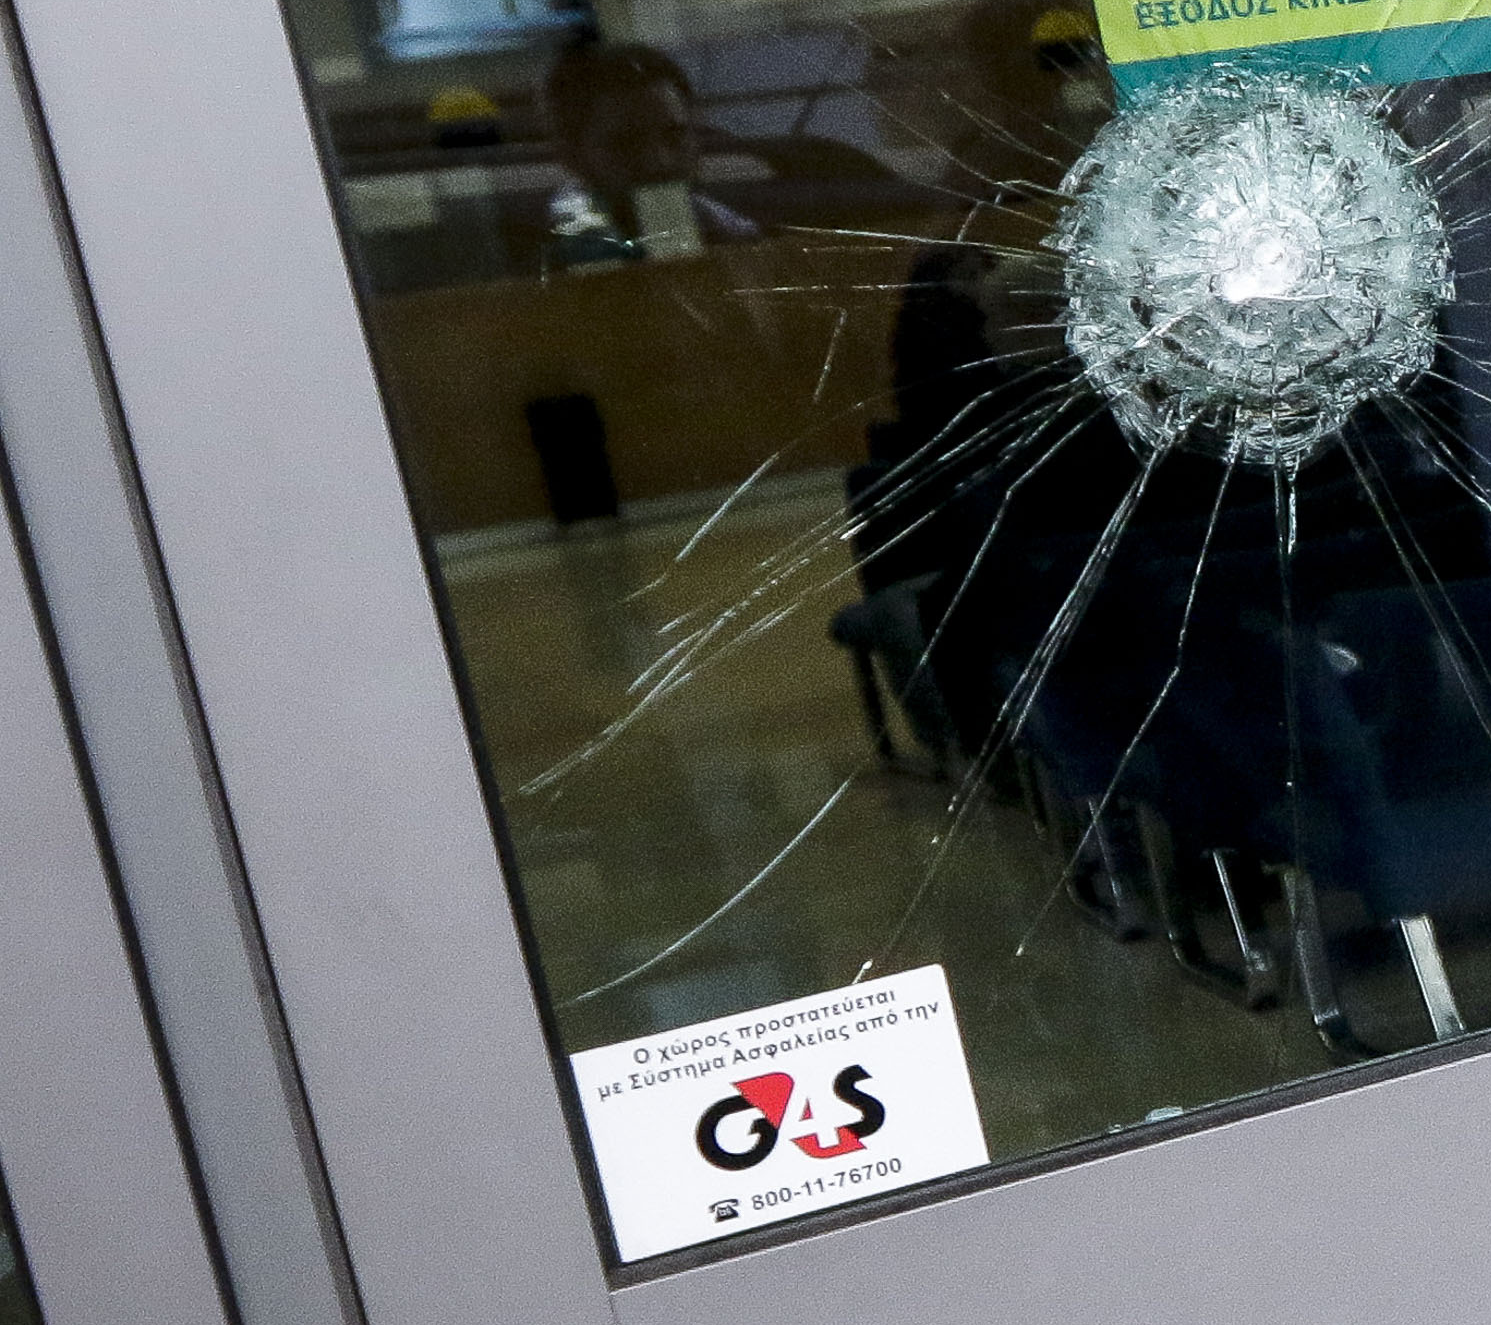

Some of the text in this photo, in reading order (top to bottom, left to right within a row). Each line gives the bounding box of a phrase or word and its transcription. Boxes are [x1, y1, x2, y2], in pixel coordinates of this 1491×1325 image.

[597, 1001, 940, 1102] με Σύστημα Ασφαλείας από την
[657, 1029, 732, 1064] χώρος
[736, 989, 896, 1039] προστατεύεται
[695, 1064, 887, 1172] G4S
[751, 1156, 903, 1212] 800-11-76700
